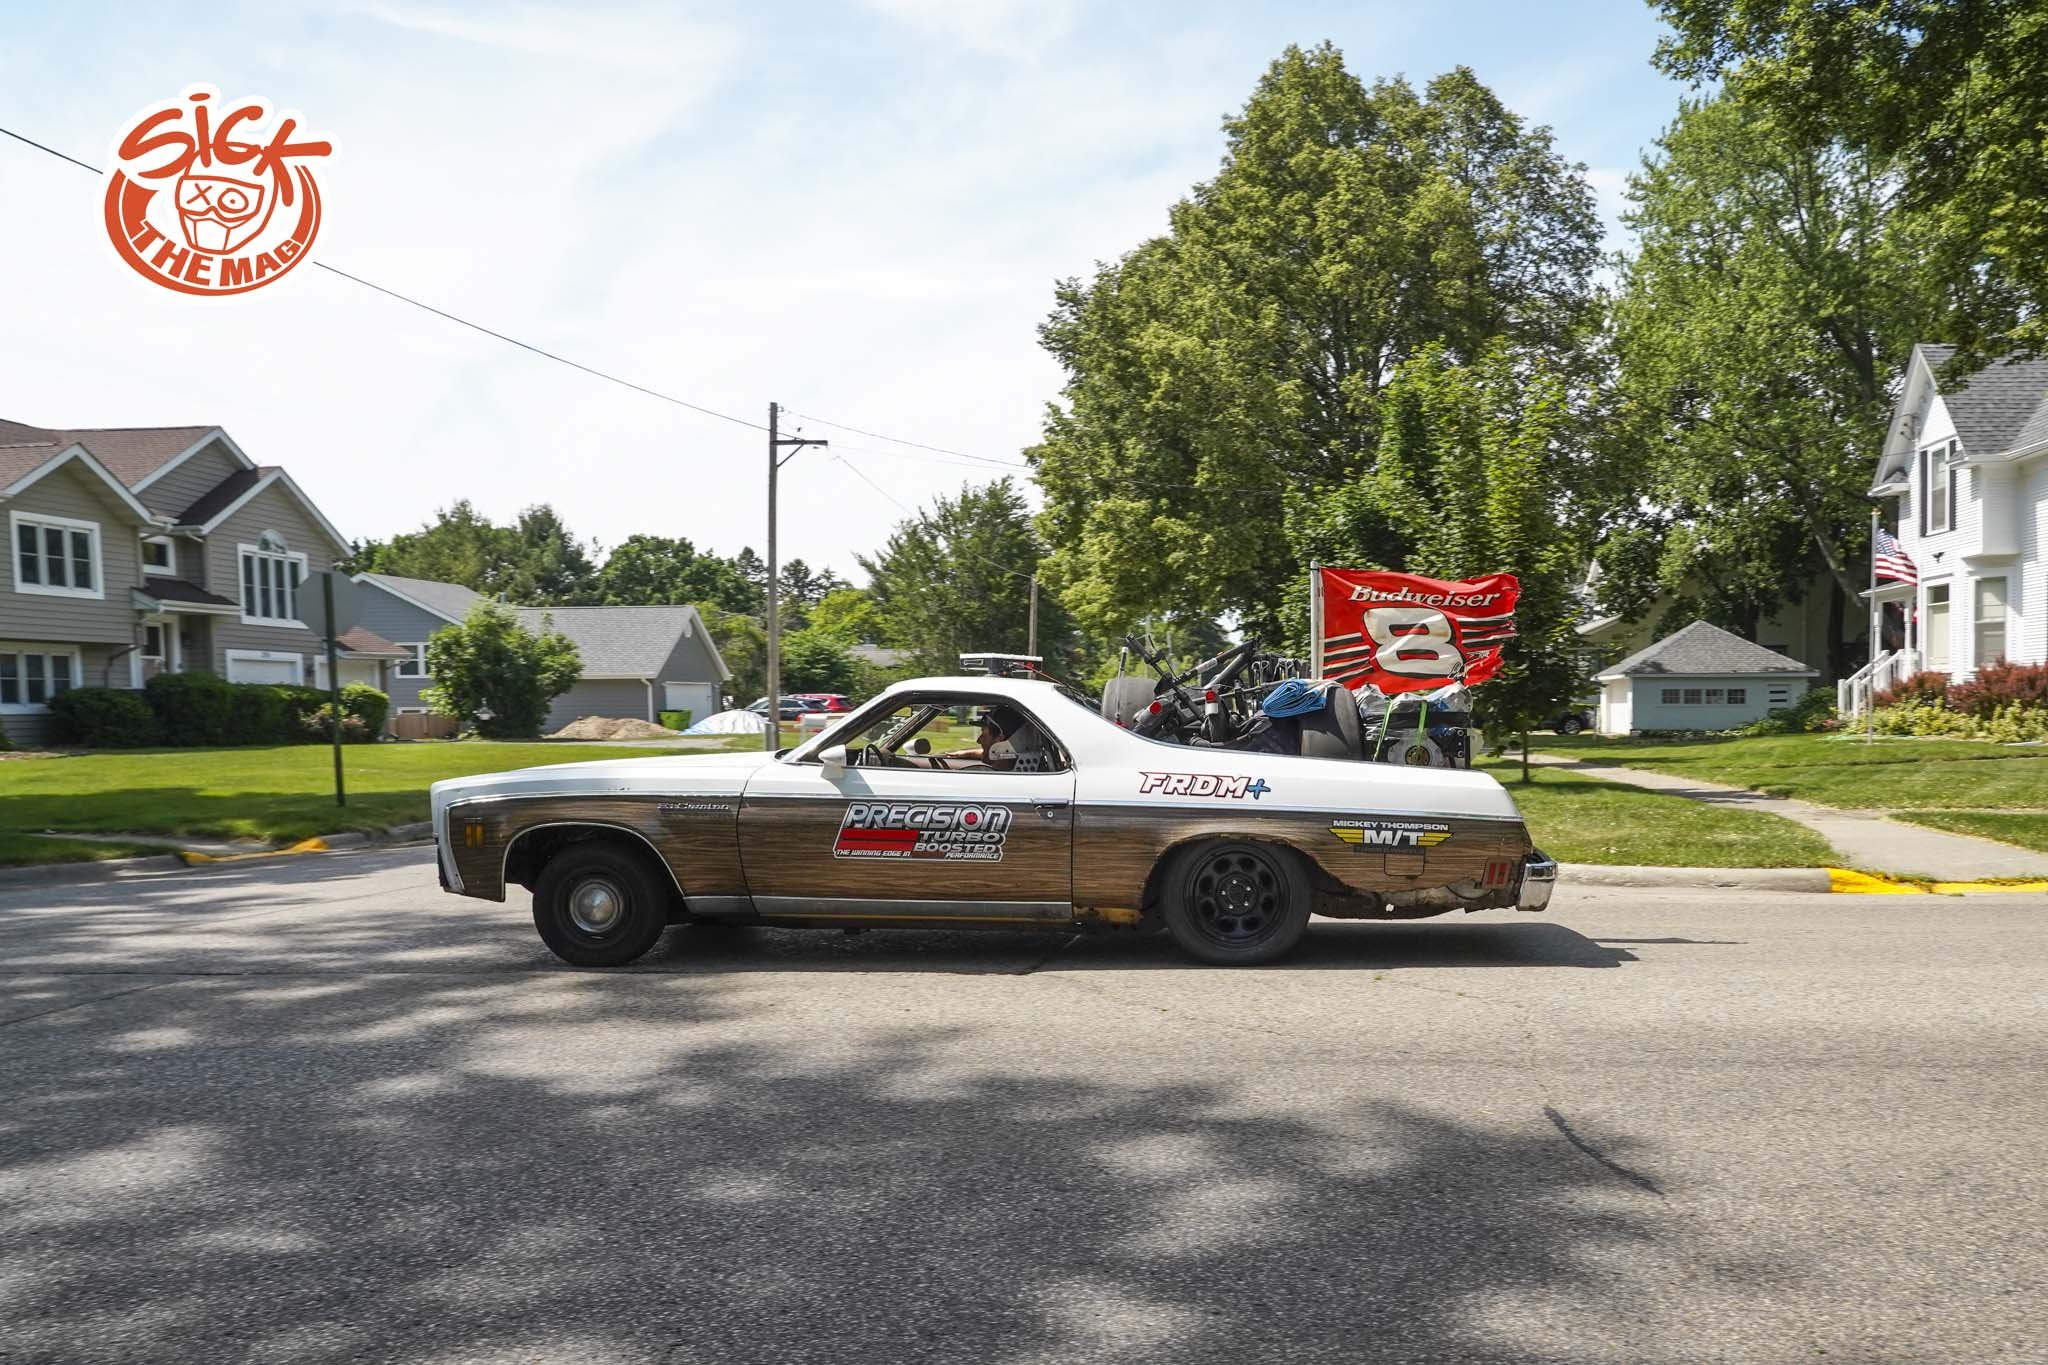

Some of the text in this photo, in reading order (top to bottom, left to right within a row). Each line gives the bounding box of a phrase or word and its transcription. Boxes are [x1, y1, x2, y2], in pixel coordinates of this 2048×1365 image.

[1349, 586, 1500, 607] Budweiser
[1363, 607, 1464, 678] 8
[845, 804, 1008, 831] PRECISION
[1333, 820, 1449, 831] MICKEY THOMPSON
[919, 831, 1000, 842] TURBO
[1363, 829, 1424, 847] M/T
[914, 842, 996, 853] BOOSTED
[945, 851, 999, 860] PERFORMANCE
